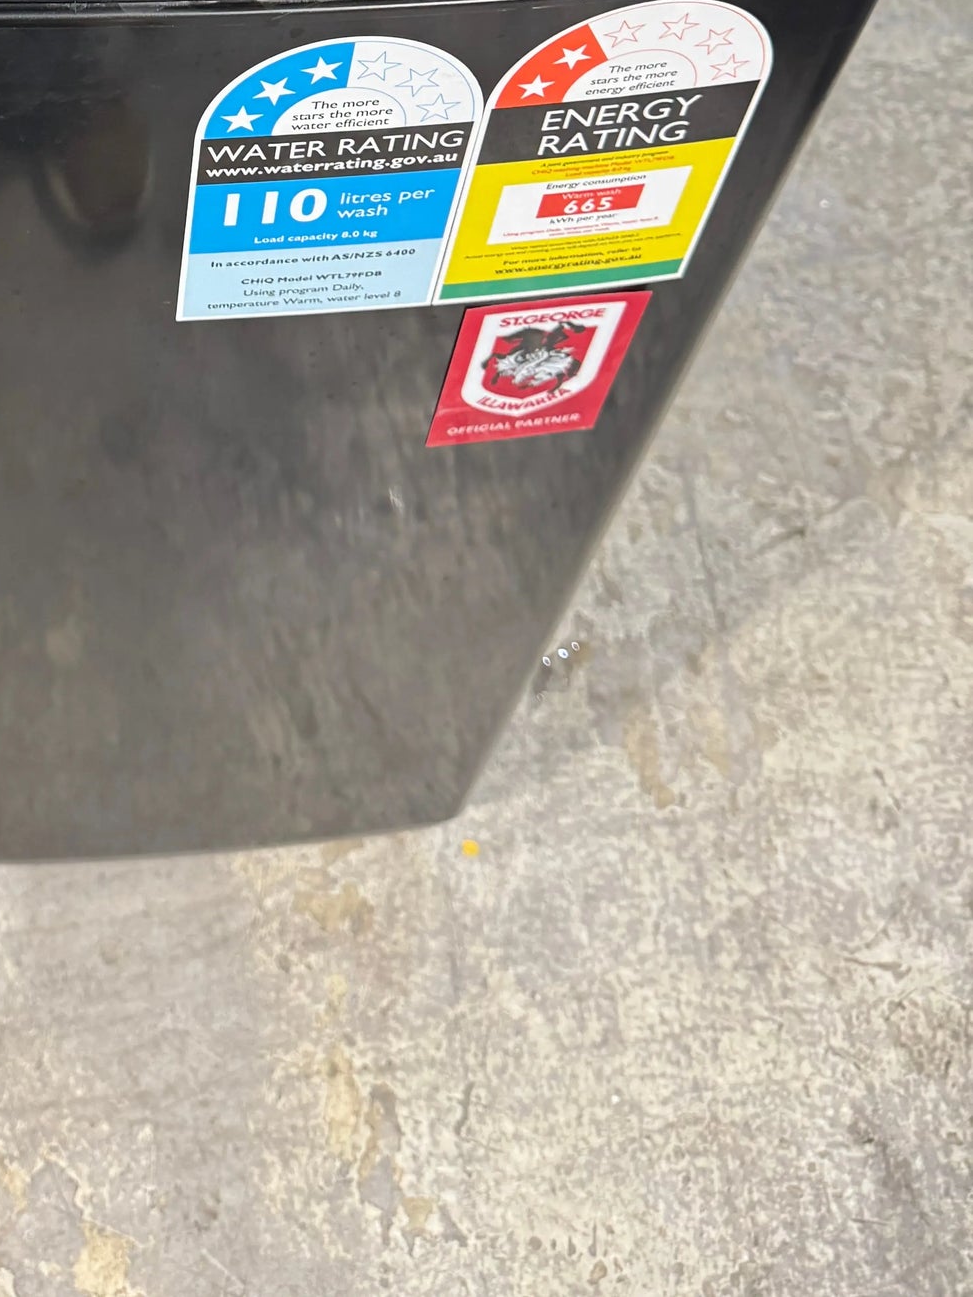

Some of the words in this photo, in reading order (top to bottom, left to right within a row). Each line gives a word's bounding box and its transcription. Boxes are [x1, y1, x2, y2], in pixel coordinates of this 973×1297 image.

[609, 64, 633, 74] The
[635, 61, 668, 71] more
[590, 77, 621, 86] stars
[623, 73, 643, 82] the
[644, 69, 679, 79] more
[585, 85, 626, 96] energy
[628, 79, 676, 91] efficient
[311, 100, 338, 110] The
[342, 98, 380, 108] more
[292, 112, 325, 121] stars
[329, 109, 353, 119] the
[356, 107, 393, 117] more
[540, 94, 704, 132] ENERGY
[291, 122, 331, 131] water
[335, 117, 390, 129] efficient
[207, 141, 326, 163] WATER
[337, 129, 465, 156] RATING
[537, 120, 691, 156] RATING
[206, 152, 458, 178] www.waterrating.gov.au
[546, 181, 581, 190] Energy
[582, 174, 647, 187] consumption
[562, 192, 594, 200] Warm
[597, 188, 622, 197] wash
[223, 188, 328, 227] 110
[340, 190, 392, 205] litres
[398, 187, 436, 204] per
[337, 204, 389, 219] wash
[563, 196, 614, 214] 665
[253, 234, 285, 244] Load
[287, 231, 339, 244] capacity
[341, 229, 360, 239] 8.0
[363, 228, 378, 239] kg
[211, 260, 223, 268] In
[226, 258, 299, 268] accordance
[301, 255, 330, 263] with
[330, 250, 383, 262] AS/NZS
[385, 248, 417, 257] 6400
[277, 274, 313, 284] Model
[316, 270, 383, 281] WTL79FDB
[207, 300, 280, 311] temperature
[326, 294, 362, 302] water
[364, 291, 391, 300] level
[393, 290, 402, 298] 8
[243, 287, 276, 298] Using
[278, 286, 329, 297] program
[500, 308, 607, 328] ST.GEORGE
[476, 387, 573, 412] ILLAWARRA
[446, 423, 512, 437] OFFICIAL
[514, 413, 581, 429] PARTNER
